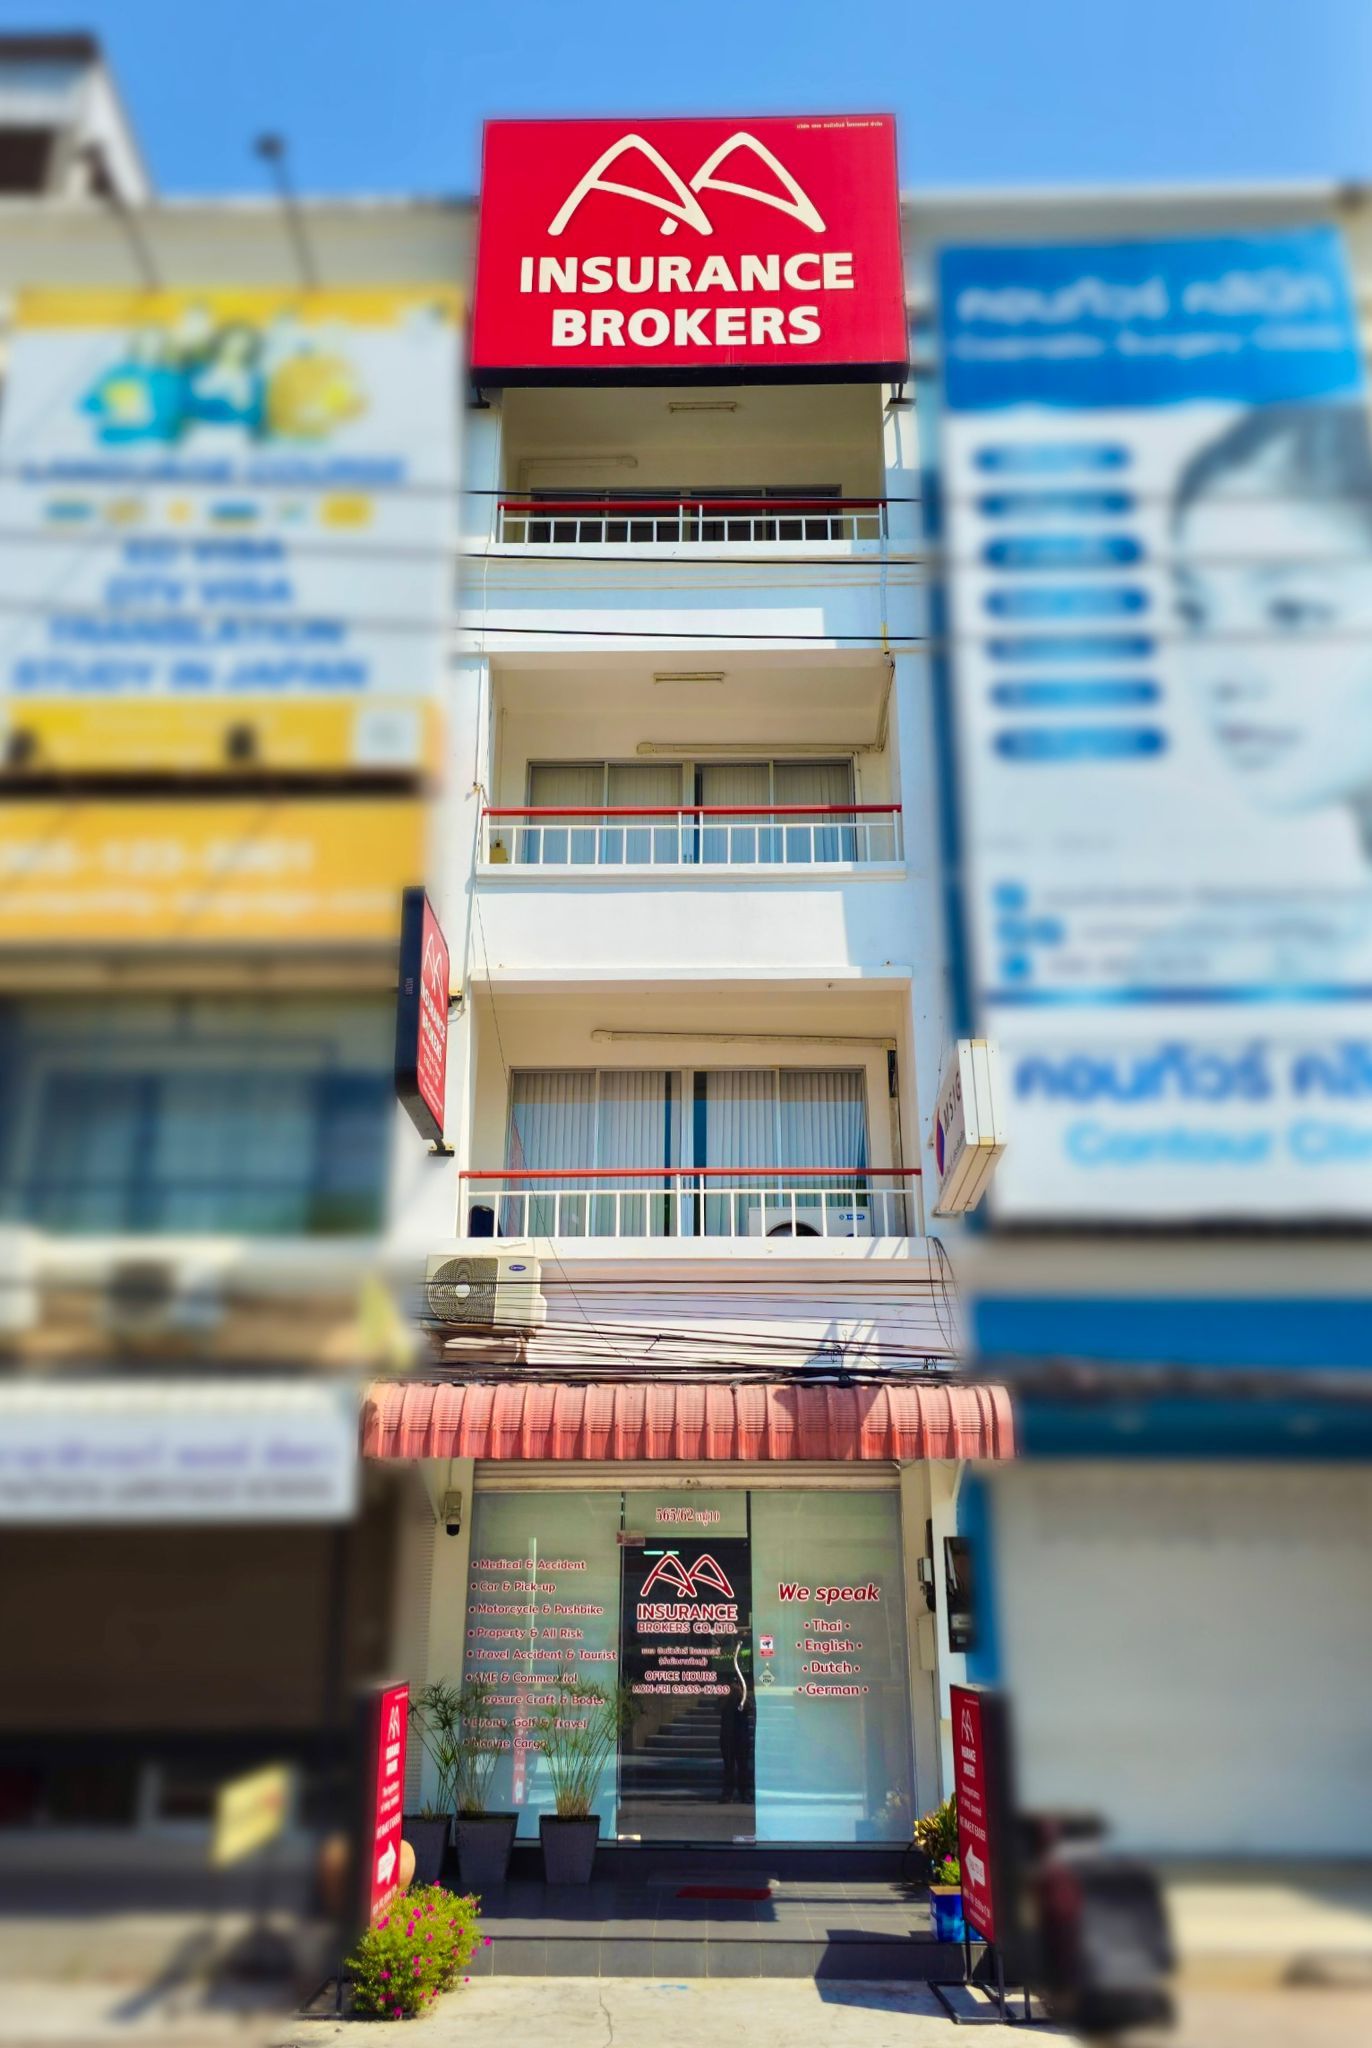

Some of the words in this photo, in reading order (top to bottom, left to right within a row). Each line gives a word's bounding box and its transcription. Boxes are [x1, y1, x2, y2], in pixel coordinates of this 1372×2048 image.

[520, 252, 854, 294] INSURANCE
[552, 306, 821, 347] BROKERS
[656, 1508, 694, 1523] 565/62
[479, 1558, 522, 1570] Medical
[525, 1558, 534, 1570] &
[538, 1558, 587, 1570] Accident
[480, 1582, 498, 1592] Car
[502, 1582, 510, 1592] &
[514, 1582, 556, 1594] Pick-up
[778, 1582, 810, 1601] We
[815, 1582, 881, 1606] speak
[478, 1603, 539, 1616] Motorcycle
[542, 1603, 551, 1614] &
[554, 1603, 604, 1615] Pushbike
[637, 1603, 738, 1620] INSURANCE
[637, 1621, 690, 1633] BROKERS
[813, 1619, 842, 1632] Thai
[476, 1628, 525, 1640] Property
[529, 1628, 538, 1638] &
[542, 1628, 557, 1639] All
[560, 1628, 584, 1639] Risk
[804, 1639, 854, 1655] English
[476, 1650, 509, 1661] Travel
[513, 1650, 562, 1661] Accident
[566, 1650, 575, 1660] &
[578, 1650, 617, 1661] Tourist
[810, 1661, 852, 1674] Dutch
[501, 1672, 510, 1683] &
[645, 1671, 680, 1682] OFFICE
[682, 1671, 717, 1681] HOURS
[805, 1683, 860, 1696] German
[526, 1694, 555, 1705] Craft
[513, 1717, 536, 1728] Golf
